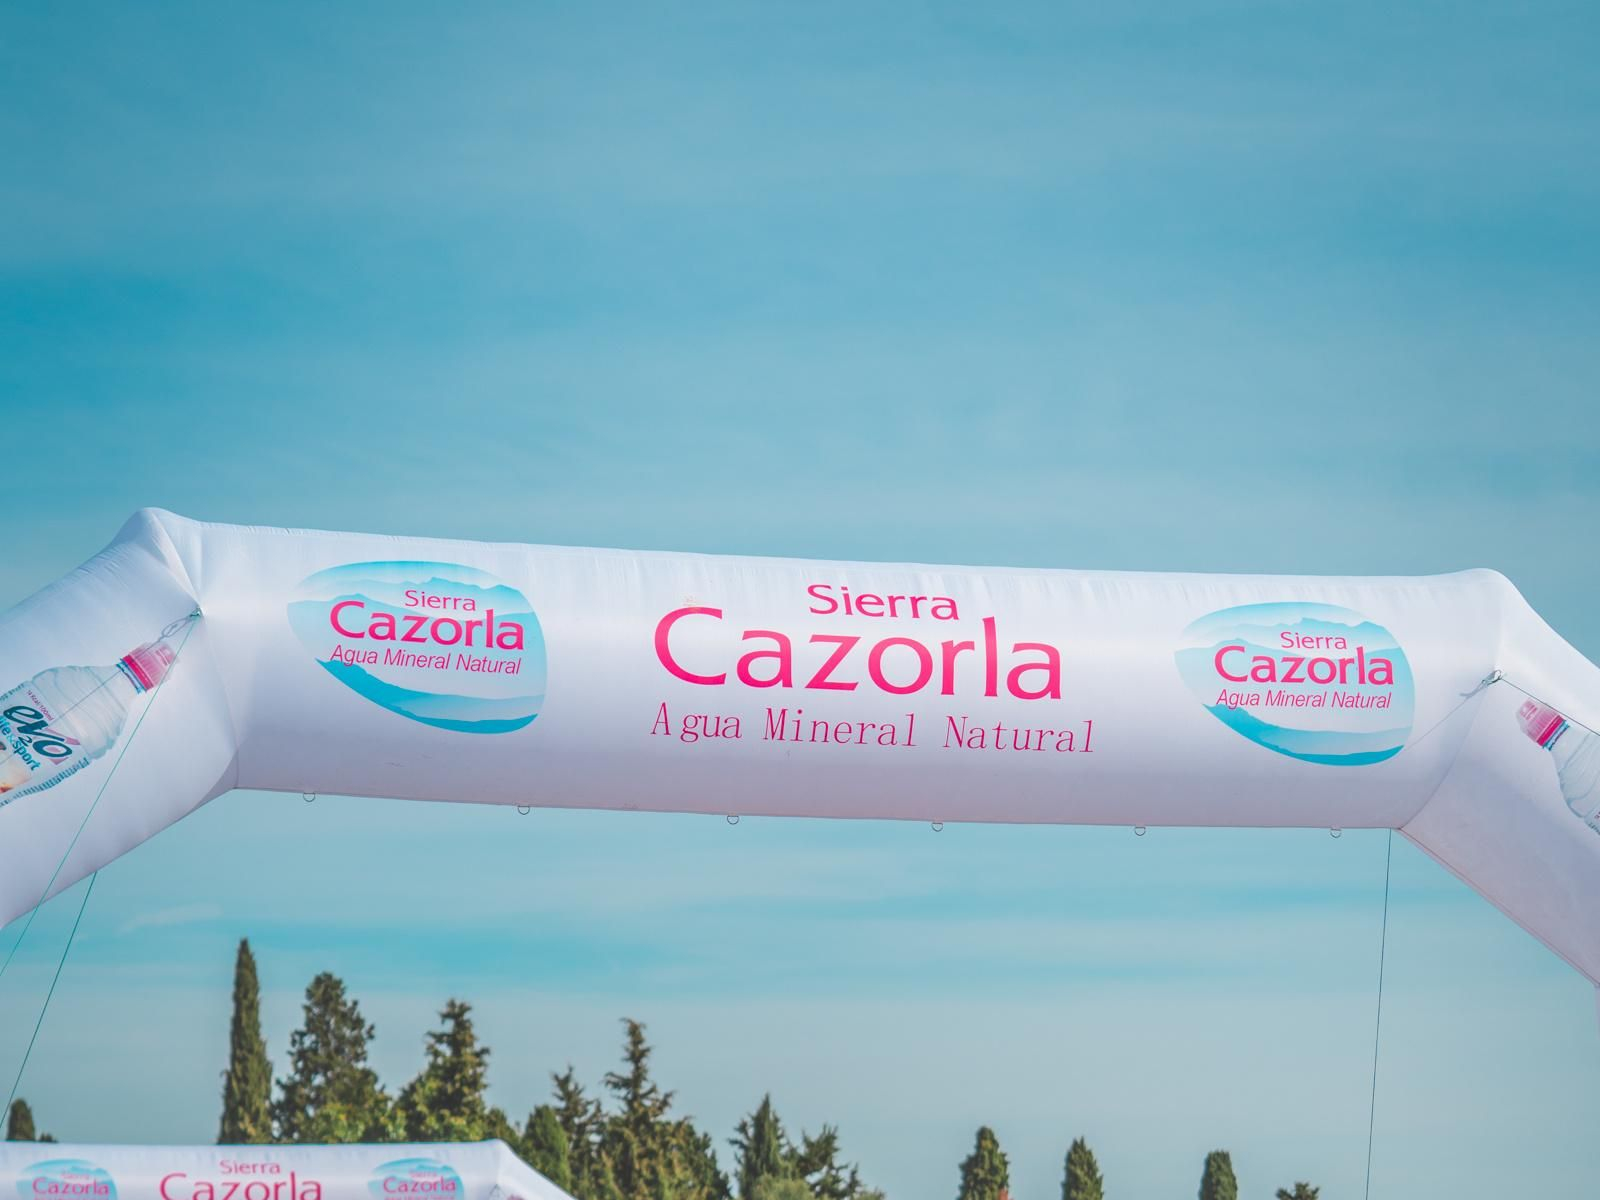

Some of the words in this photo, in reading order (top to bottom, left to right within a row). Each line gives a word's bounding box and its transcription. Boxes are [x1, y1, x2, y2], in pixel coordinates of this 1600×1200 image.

[404, 589, 477, 613] Sierra
[805, 582, 961, 622] Sierra
[329, 599, 525, 651] Cazorla
[652, 605, 1063, 702] Cazorla
[1279, 631, 1348, 651] Sierra
[328, 643, 379, 667] Agua
[383, 647, 451, 671] Mineral
[454, 653, 522, 676] Natural
[1213, 644, 1395, 687] Cazorla
[1215, 688, 1261, 710] Agua
[1264, 689, 1328, 709] Mineral
[1330, 690, 1393, 709] Natural
[652, 701, 742, 744] Agua
[763, 706, 916, 748] Mineral
[944, 714, 1094, 753] Natural
[219, 1160, 281, 1177] Sierra
[32, 1177, 110, 1197] Cazorla
[383, 1176, 456, 1194] Cazorla
